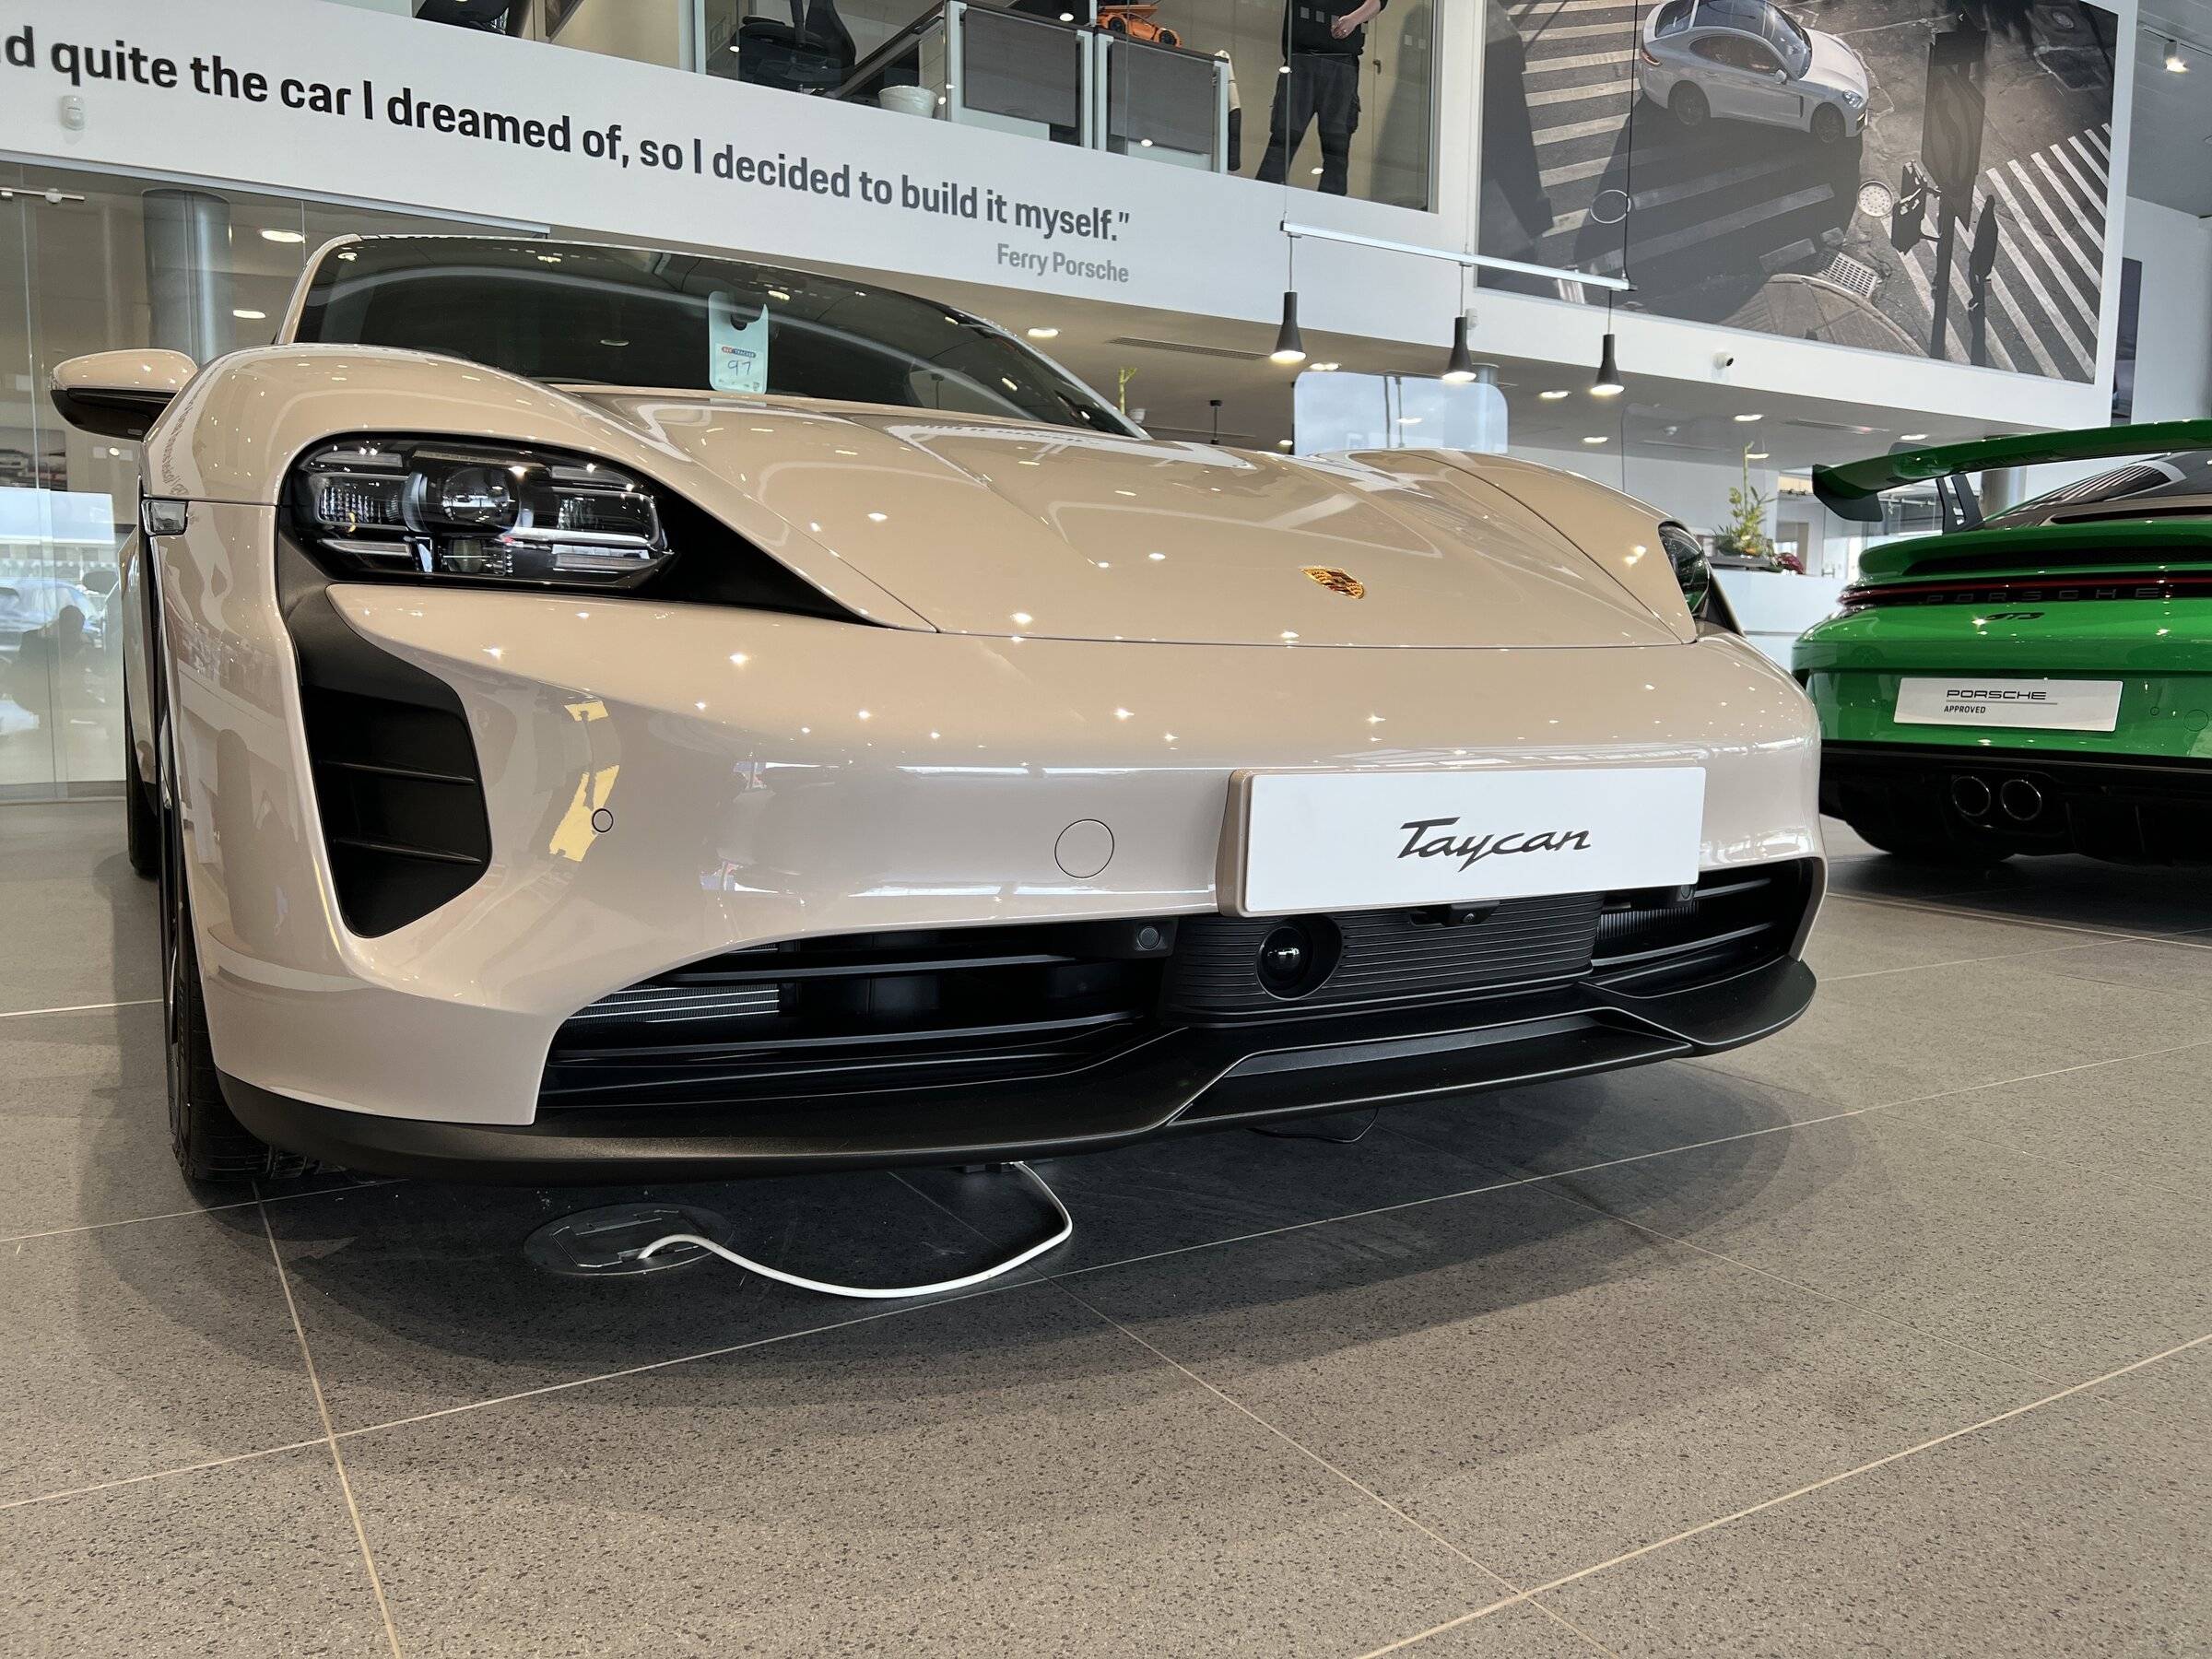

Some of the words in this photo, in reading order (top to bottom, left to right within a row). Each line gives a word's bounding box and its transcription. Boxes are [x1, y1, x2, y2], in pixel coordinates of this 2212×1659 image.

[0, 25, 35, 68] d
[52, 40, 178, 88] quite
[190, 55, 267, 102] the
[281, 79, 351, 116] car
[362, 79, 374, 121] I
[388, 88, 571, 153] dreamed
[583, 124, 629, 169] of,
[641, 140, 683, 171] so
[693, 137, 702, 174] I
[713, 145, 850, 198] decided
[859, 171, 893, 205] to
[901, 175, 978, 219] build
[986, 189, 1007, 224] it
[997, 242, 1049, 276] Ferry
[1053, 252, 1129, 283] Porsche
[727, 359, 752, 376] 97
[1944, 704, 1987, 714] APPROVED
[1946, 689, 2047, 700] PORSCHE
[1397, 816, 1592, 874] Taycan
